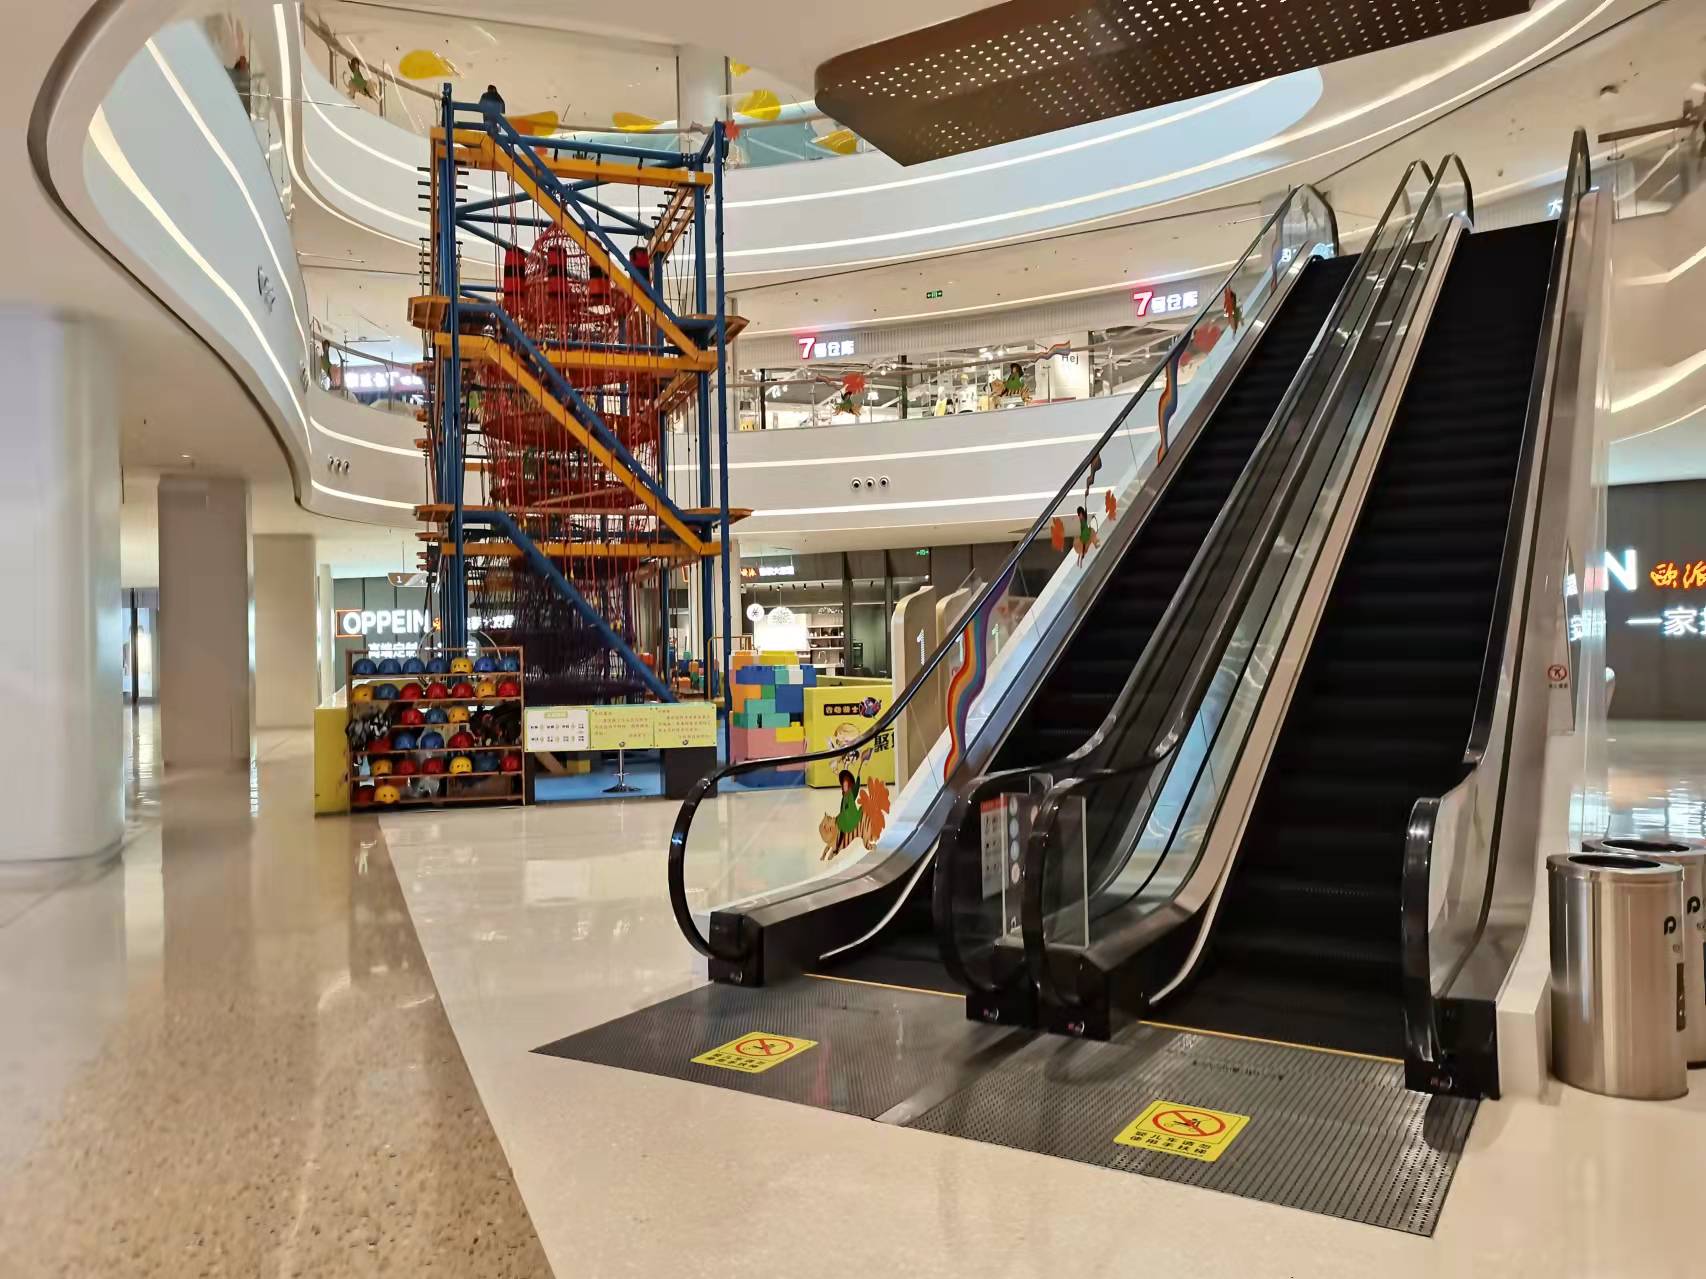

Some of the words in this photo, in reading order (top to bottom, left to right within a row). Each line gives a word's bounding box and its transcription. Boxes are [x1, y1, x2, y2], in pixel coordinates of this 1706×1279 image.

[342, 608, 431, 635] OPPEIN
[1625, 605, 1706, 636] 一家
[916, 627, 926, 666] 1
